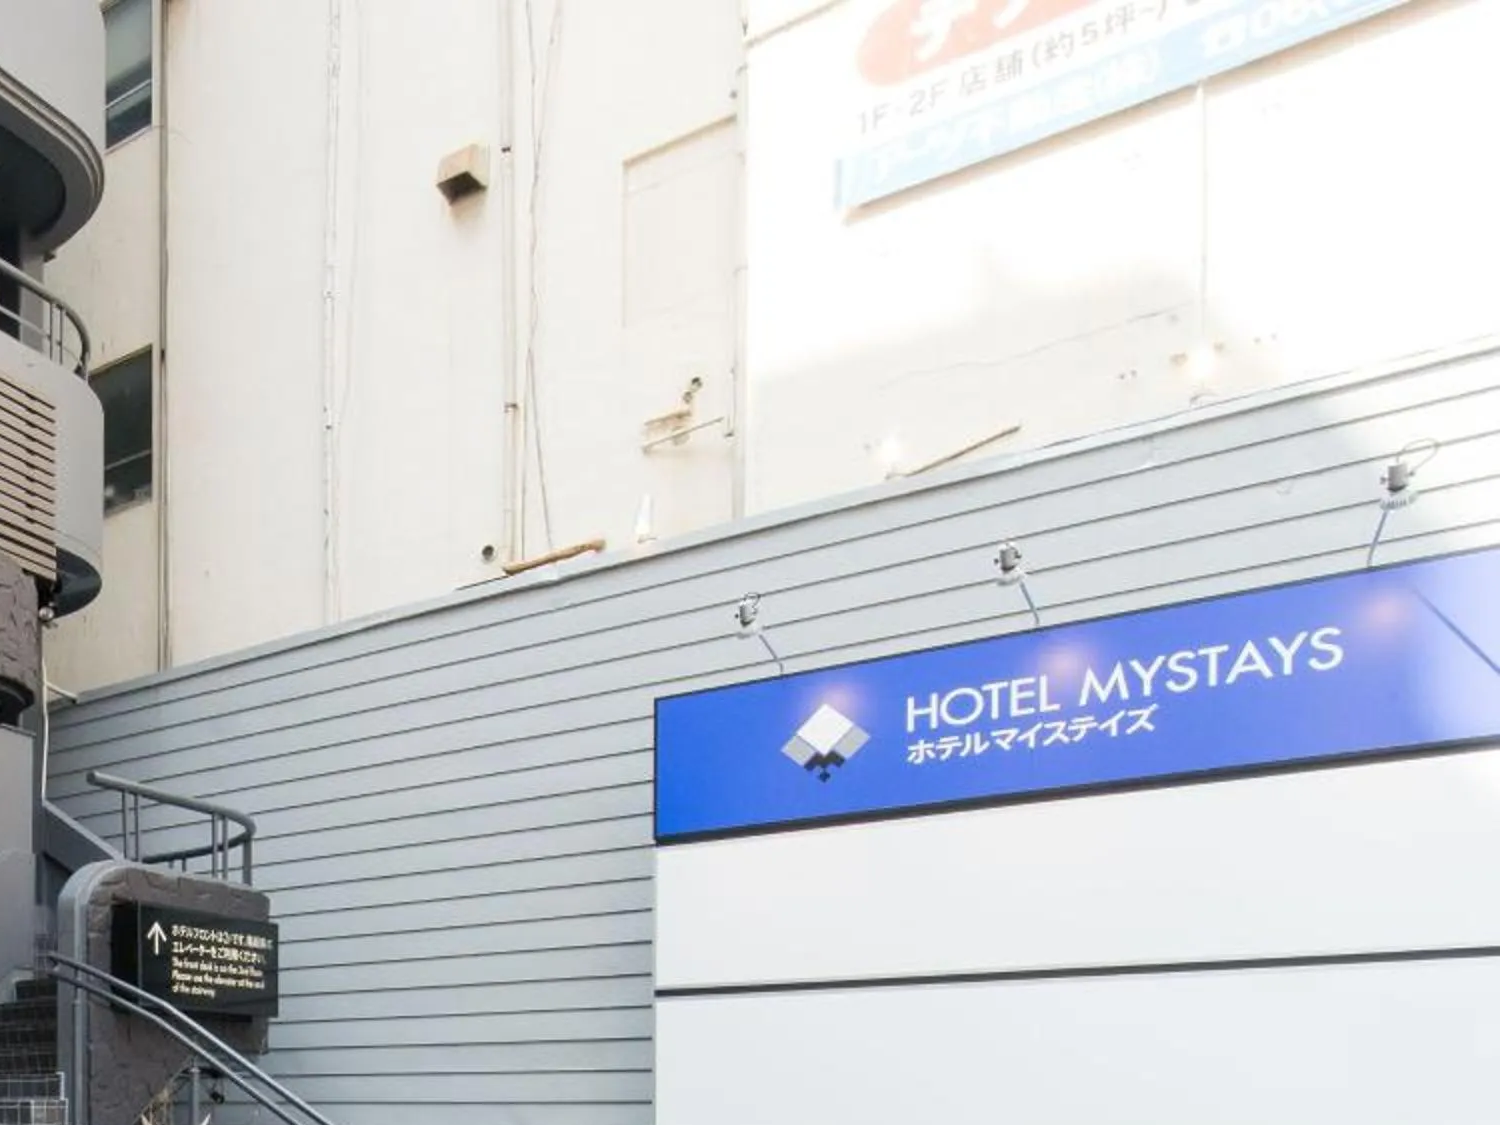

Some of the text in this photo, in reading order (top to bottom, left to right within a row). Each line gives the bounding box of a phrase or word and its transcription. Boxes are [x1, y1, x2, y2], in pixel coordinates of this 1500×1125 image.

[906, 626, 1345, 732] HOTEL MYSTAYS
[906, 703, 1159, 765] ホテルマイステイズ
